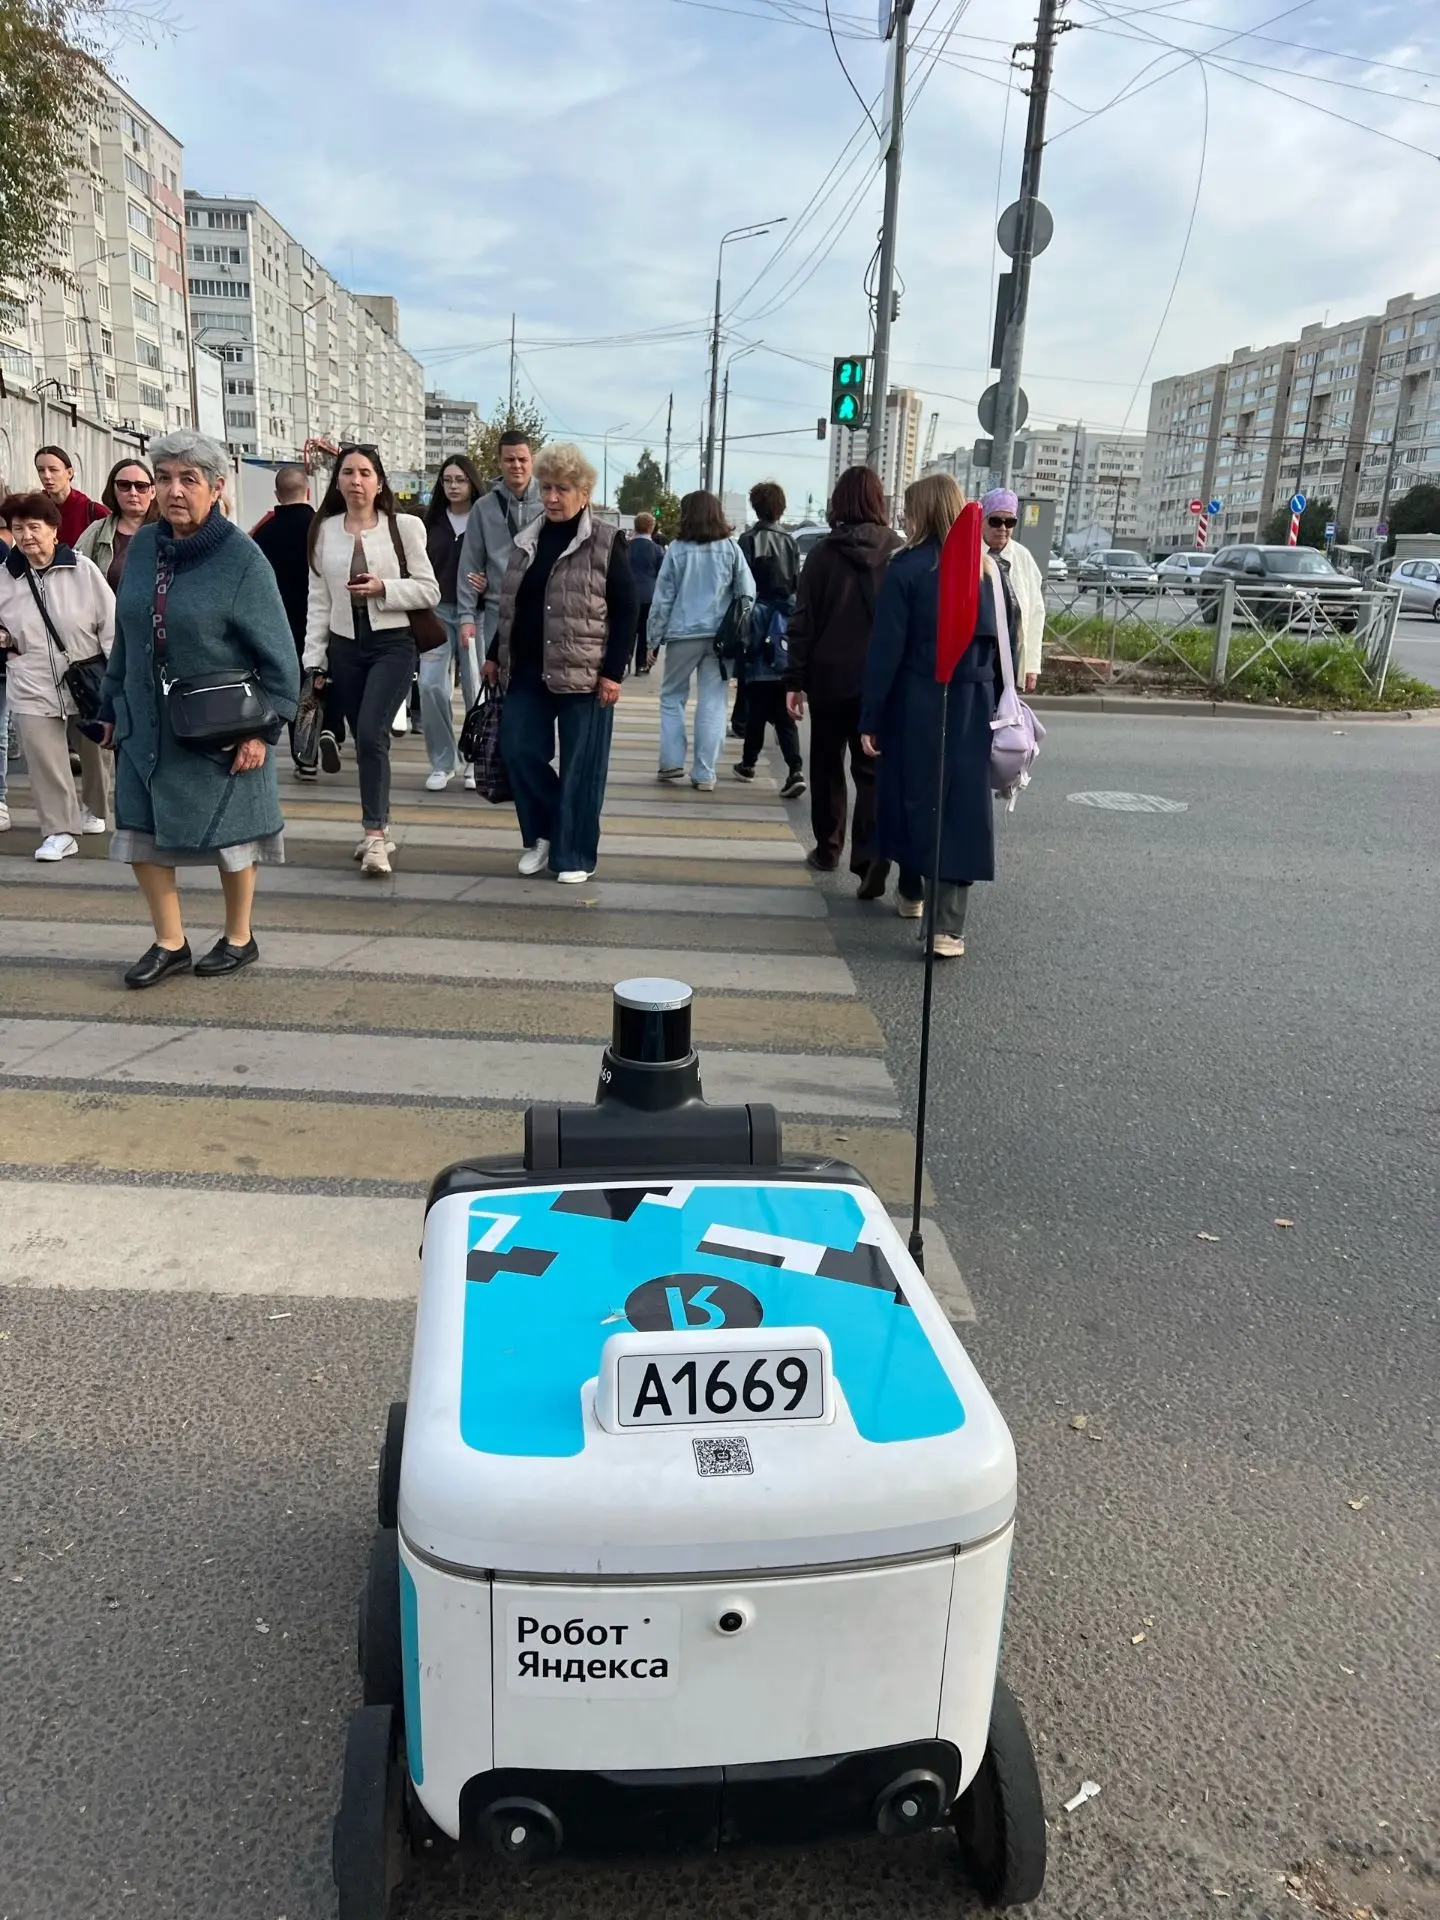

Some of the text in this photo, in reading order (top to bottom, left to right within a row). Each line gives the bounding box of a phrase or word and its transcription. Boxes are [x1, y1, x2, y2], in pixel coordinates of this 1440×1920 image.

[840, 363, 863, 385] 21
[632, 1356, 809, 1418] A1669
[517, 1616, 629, 1645] Робот
[517, 1650, 669, 1683] Яндекса
